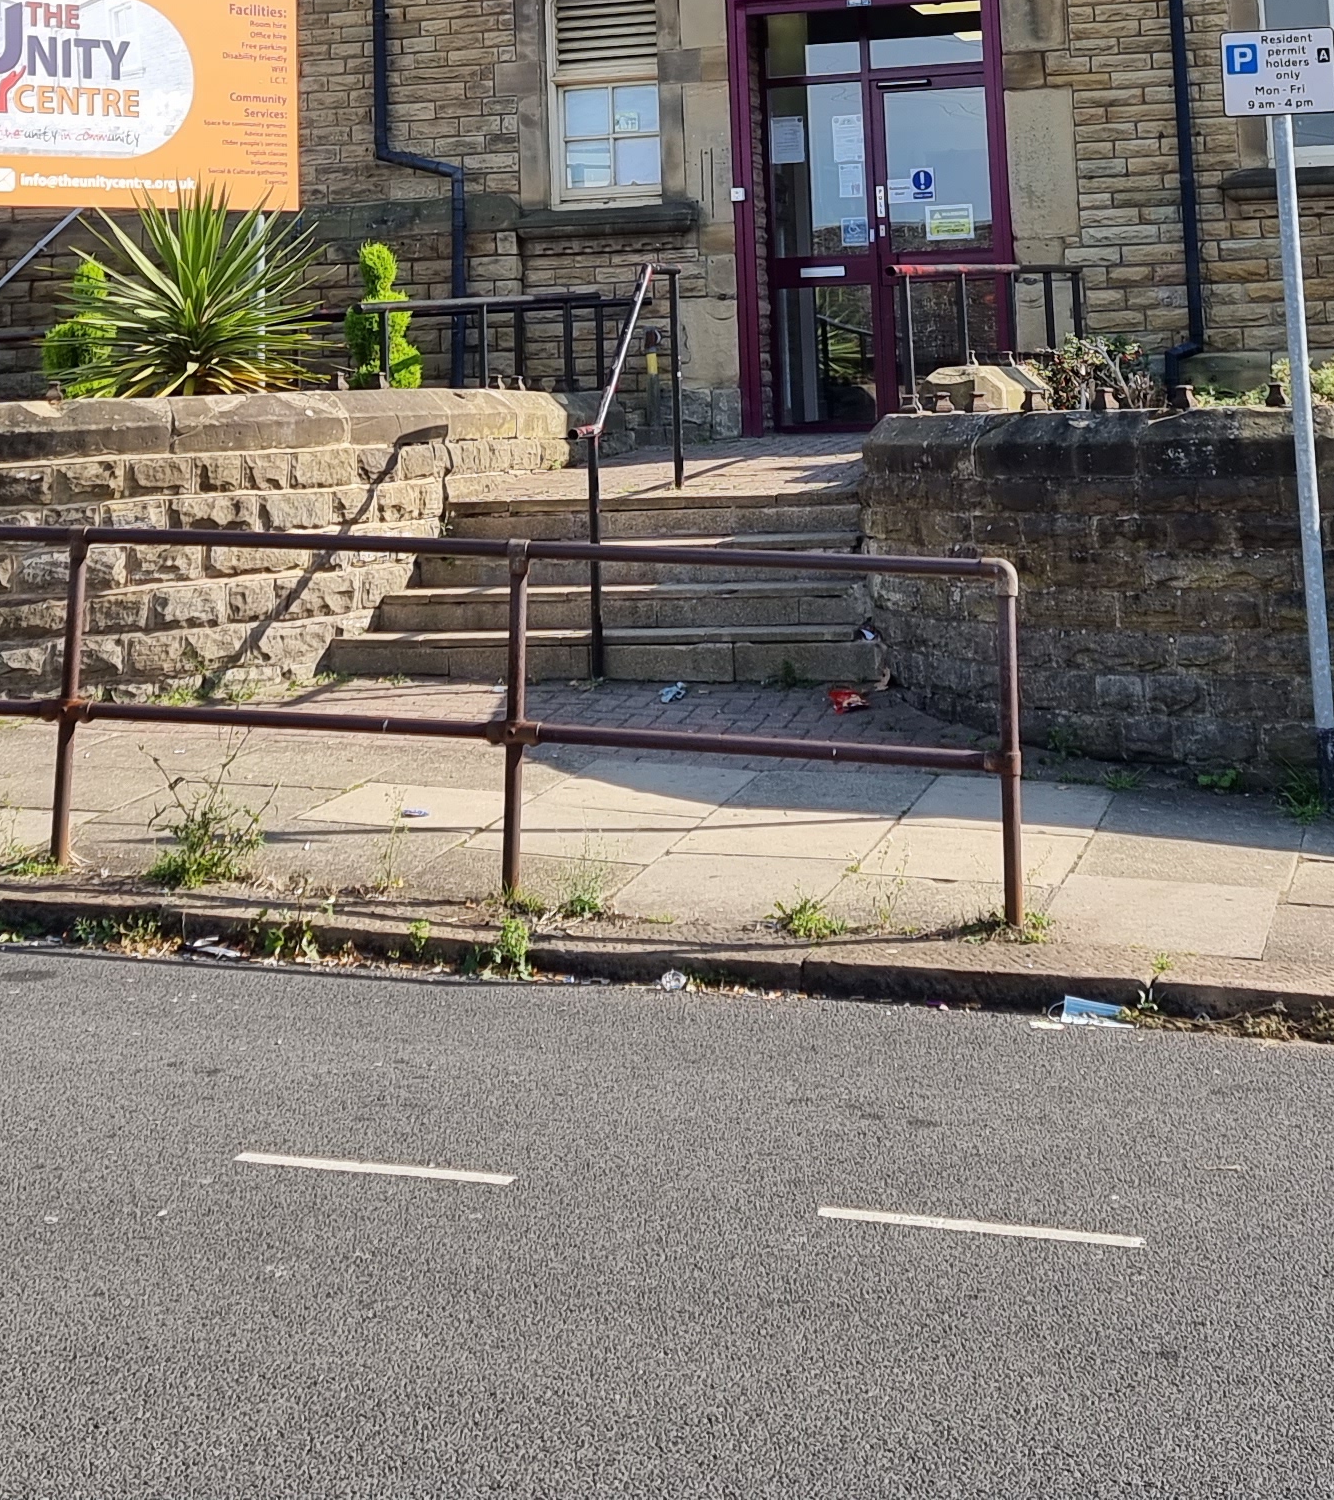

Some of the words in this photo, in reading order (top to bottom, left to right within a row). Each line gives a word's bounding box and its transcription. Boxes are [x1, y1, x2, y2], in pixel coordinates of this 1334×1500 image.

[25, 1, 80, 30] THE
[229, 3, 287, 19] Facilities:
[249, 20, 271, 28] Room
[273, 21, 287, 29] hire
[249, 31, 271, 39] Office
[273, 32, 287, 40] hire
[1261, 33, 1313, 45] Resident
[241, 42, 257, 50] Free
[259, 43, 287, 53] parking
[1267, 45, 1307, 57] permit
[222, 52, 257, 62] Disability
[259, 54, 287, 63] friendly
[1233, 47, 1253, 72] P
[1319, 50, 1329, 61] A
[1266, 58, 1310, 69] holders
[1275, 70, 1301, 81] only
[1255, 86, 1280, 96] Mon
[1290, 84, 1305, 94] Fri
[14, 84, 140, 118] CENTRE
[229, 91, 287, 106] Community
[1248, 100, 1255, 110] 9
[1258, 101, 1275, 109] am
[1284, 98, 1293, 107] 4
[1295, 99, 1314, 109] pm
[244, 108, 288, 119] Services:
[24, 126, 58, 145] unity
[61, 129, 71, 140] in
[75, 127, 140, 147] community
